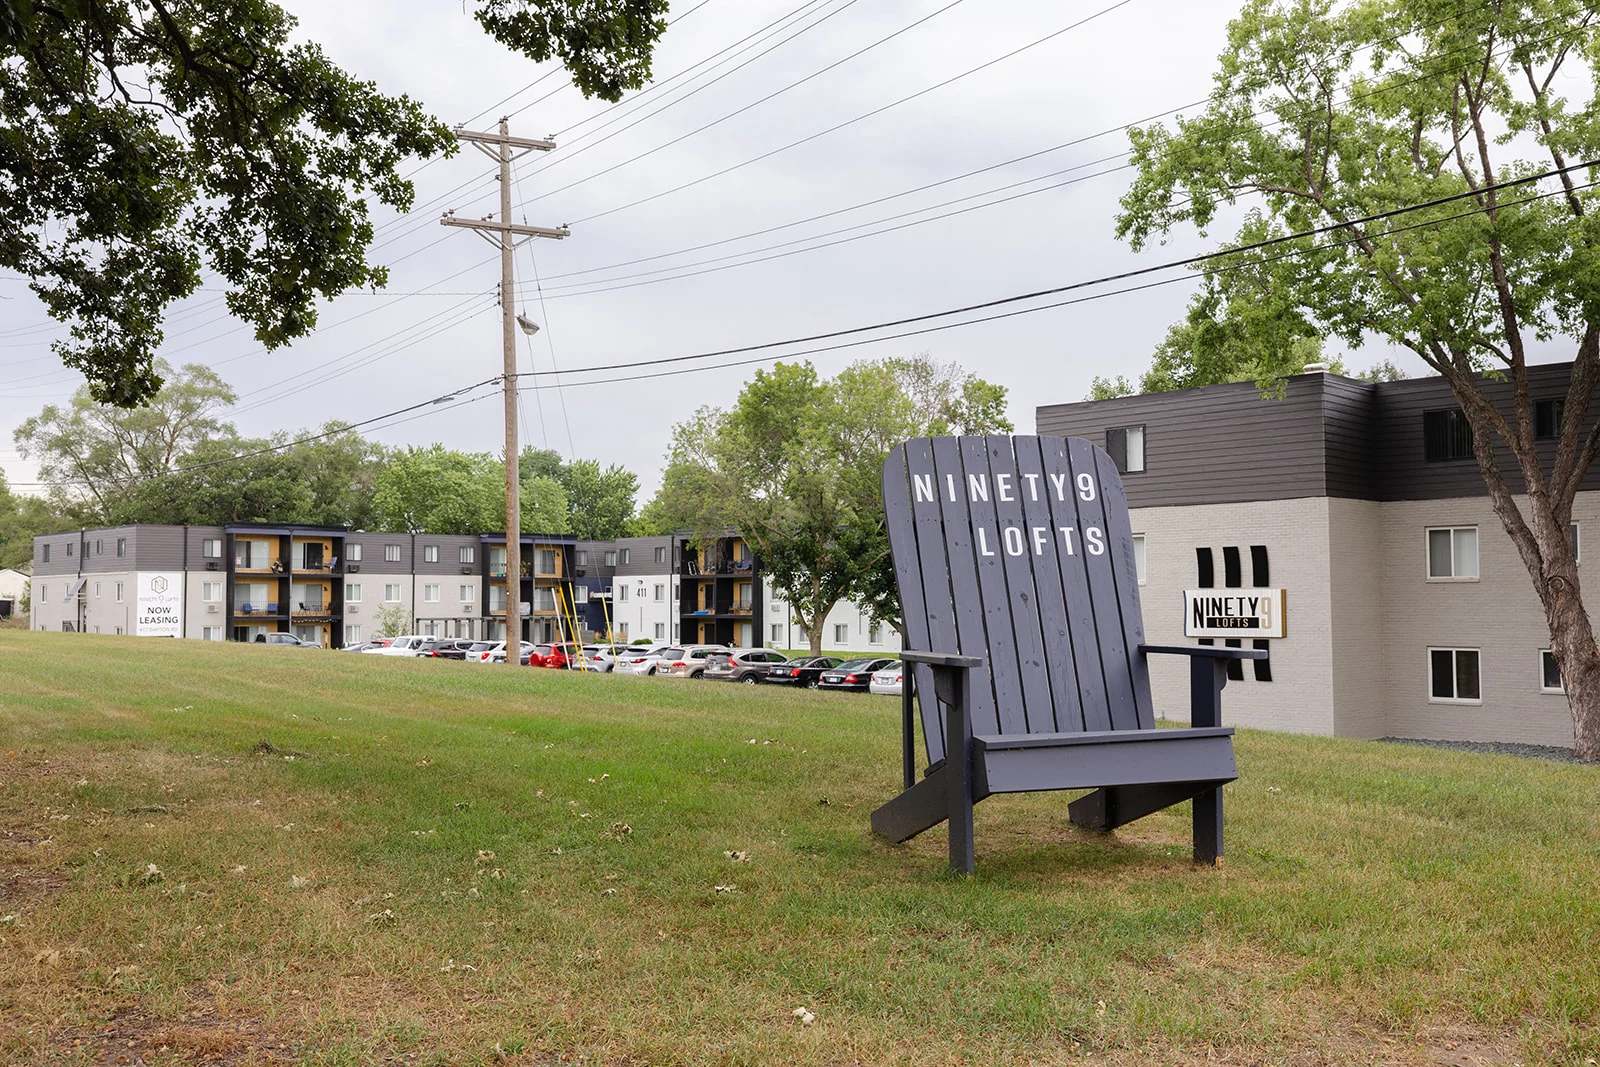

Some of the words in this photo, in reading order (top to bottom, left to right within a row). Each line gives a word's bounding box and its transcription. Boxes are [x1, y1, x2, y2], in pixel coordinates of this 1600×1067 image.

[913, 473, 1096, 502] NINETY9
[978, 526, 1105, 556] LOFTS
[636, 588, 647, 597] 411
[147, 606, 171, 614] NOW
[139, 616, 179, 624] LEASING
[1216, 618, 1249, 628] LOFTS
